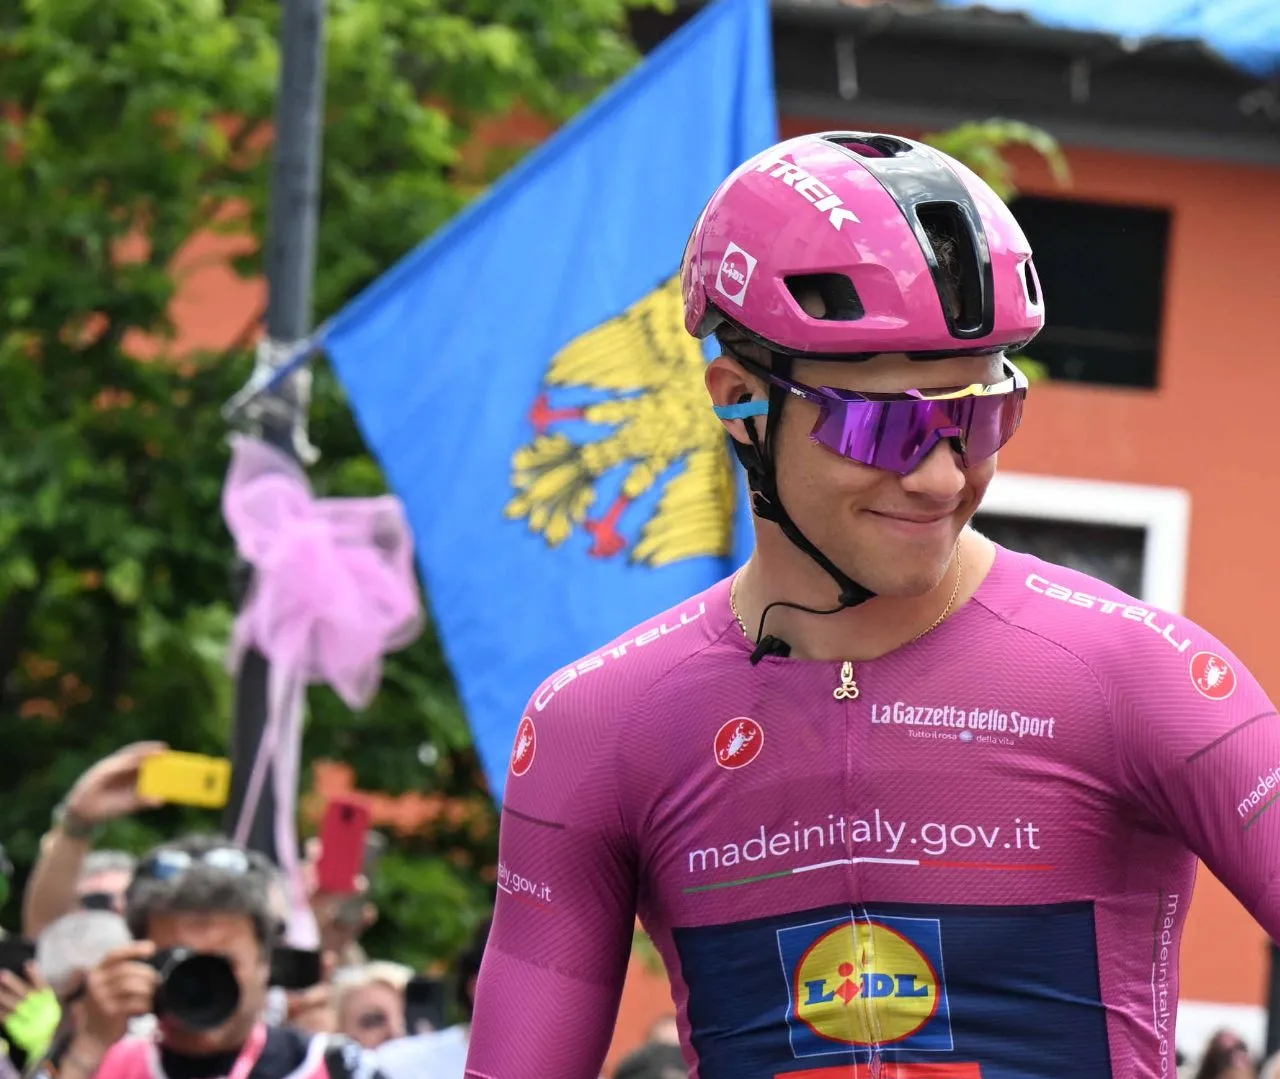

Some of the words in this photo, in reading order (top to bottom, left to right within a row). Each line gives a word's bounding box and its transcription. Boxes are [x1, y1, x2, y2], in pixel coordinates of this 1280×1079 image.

[752, 154, 862, 232] TREK
[871, 703, 891, 724] La
[893, 701, 966, 729] Gazzetta
[968, 707, 1008, 732] dello
[1009, 711, 1056, 739] Sport
[907, 729, 932, 739] Tutto
[938, 732, 957, 741] rosa
[976, 735, 997, 745] della
[998, 737, 1015, 746] vita
[688, 808, 1041, 873] madeinitaly.gov.it
